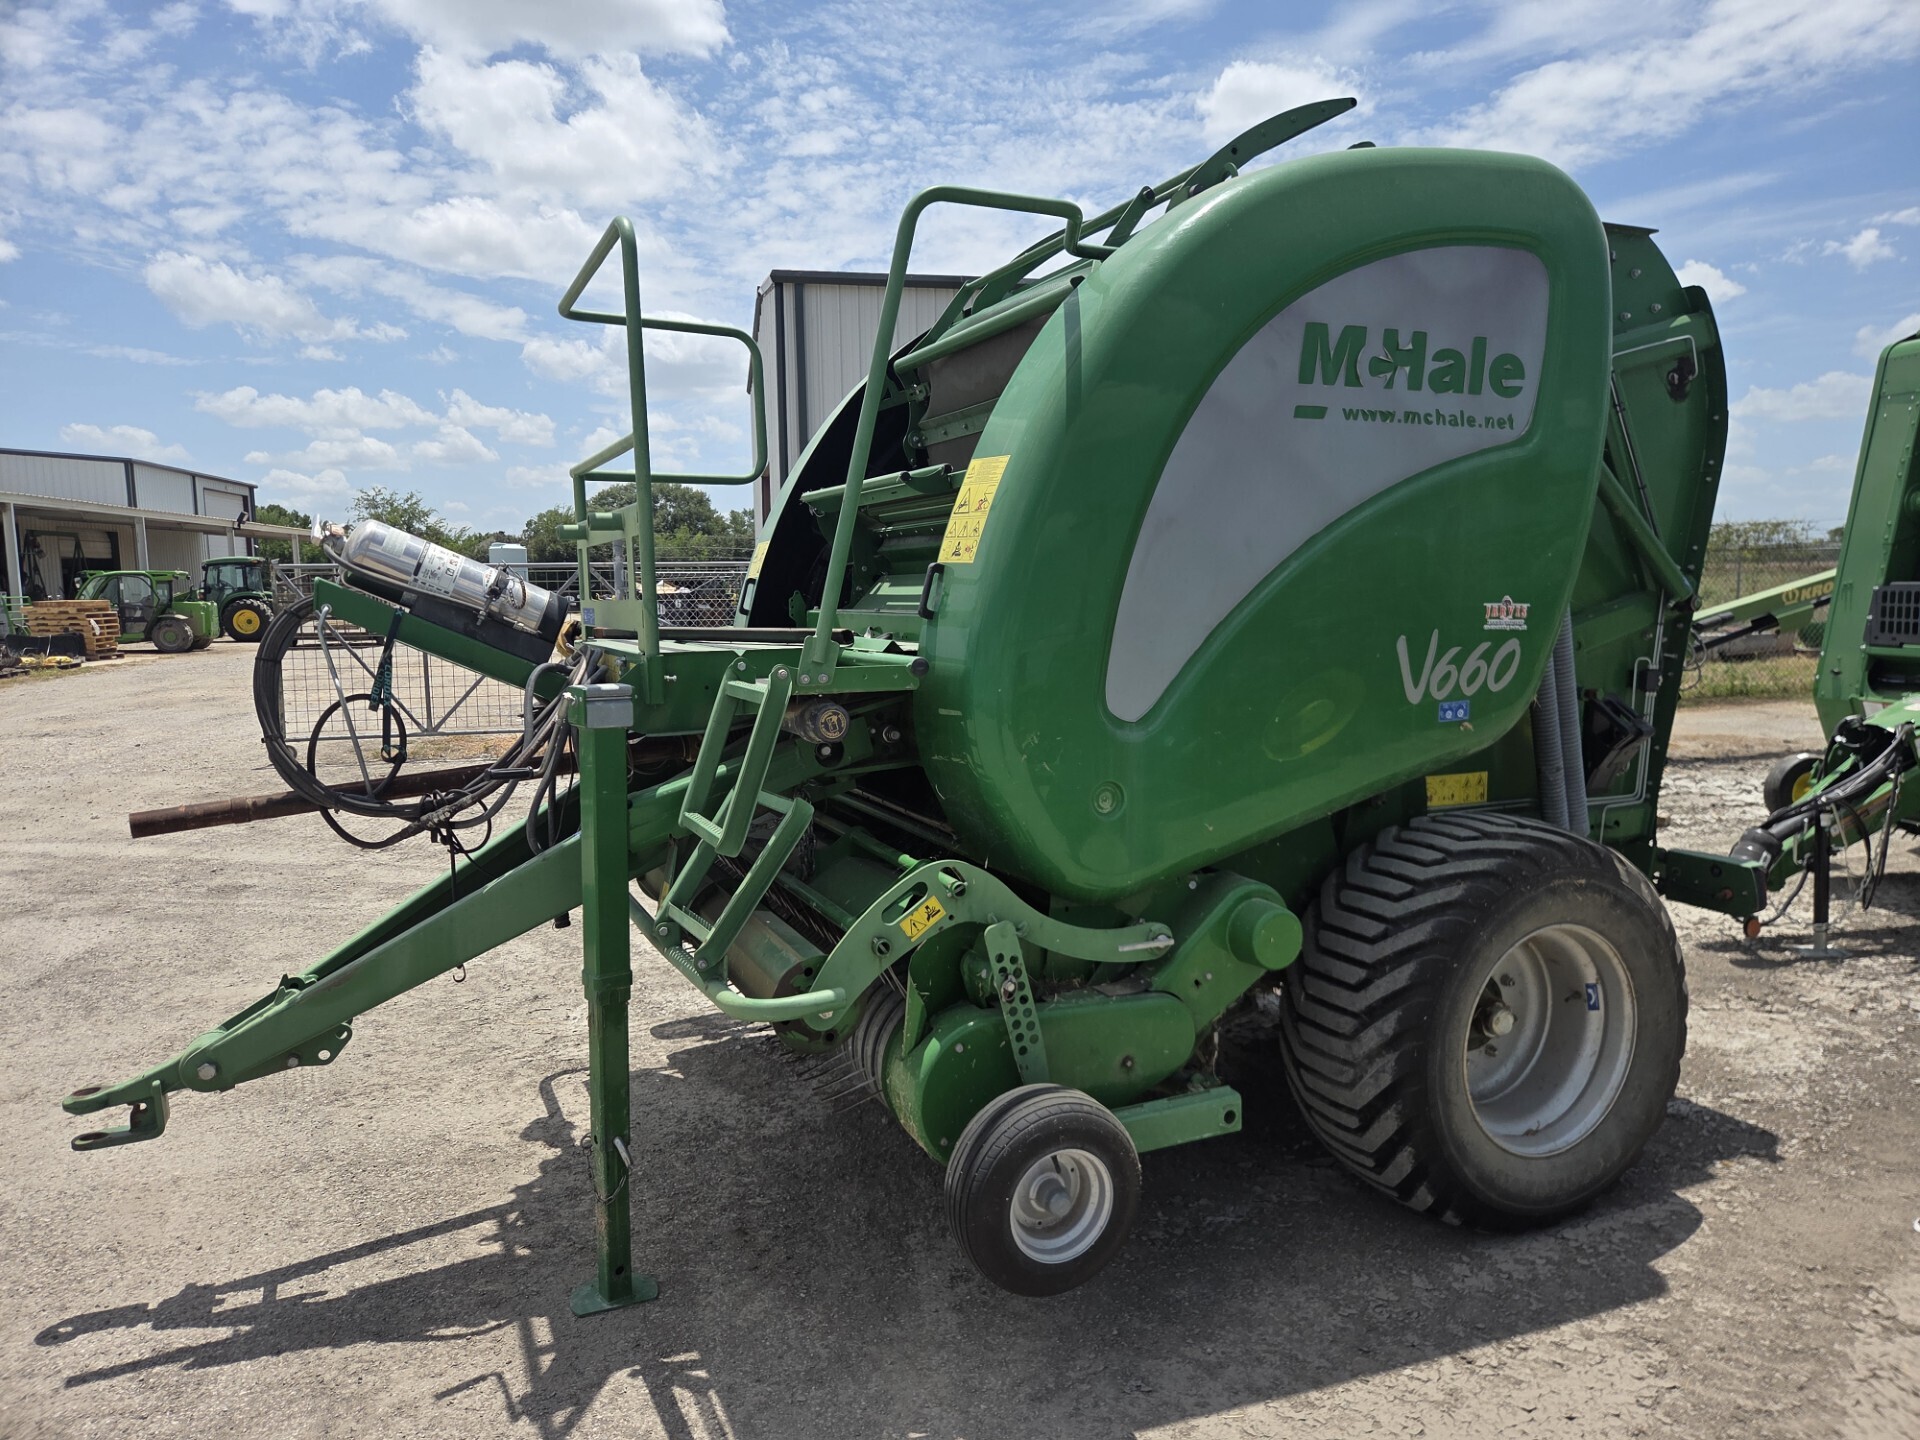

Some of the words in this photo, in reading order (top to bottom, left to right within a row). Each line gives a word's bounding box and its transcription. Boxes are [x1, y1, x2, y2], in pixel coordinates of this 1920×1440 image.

[1298, 322, 1526, 399] McHale
[1341, 407, 1514, 430] www.mchale.net
[1396, 628, 1521, 705] V660
